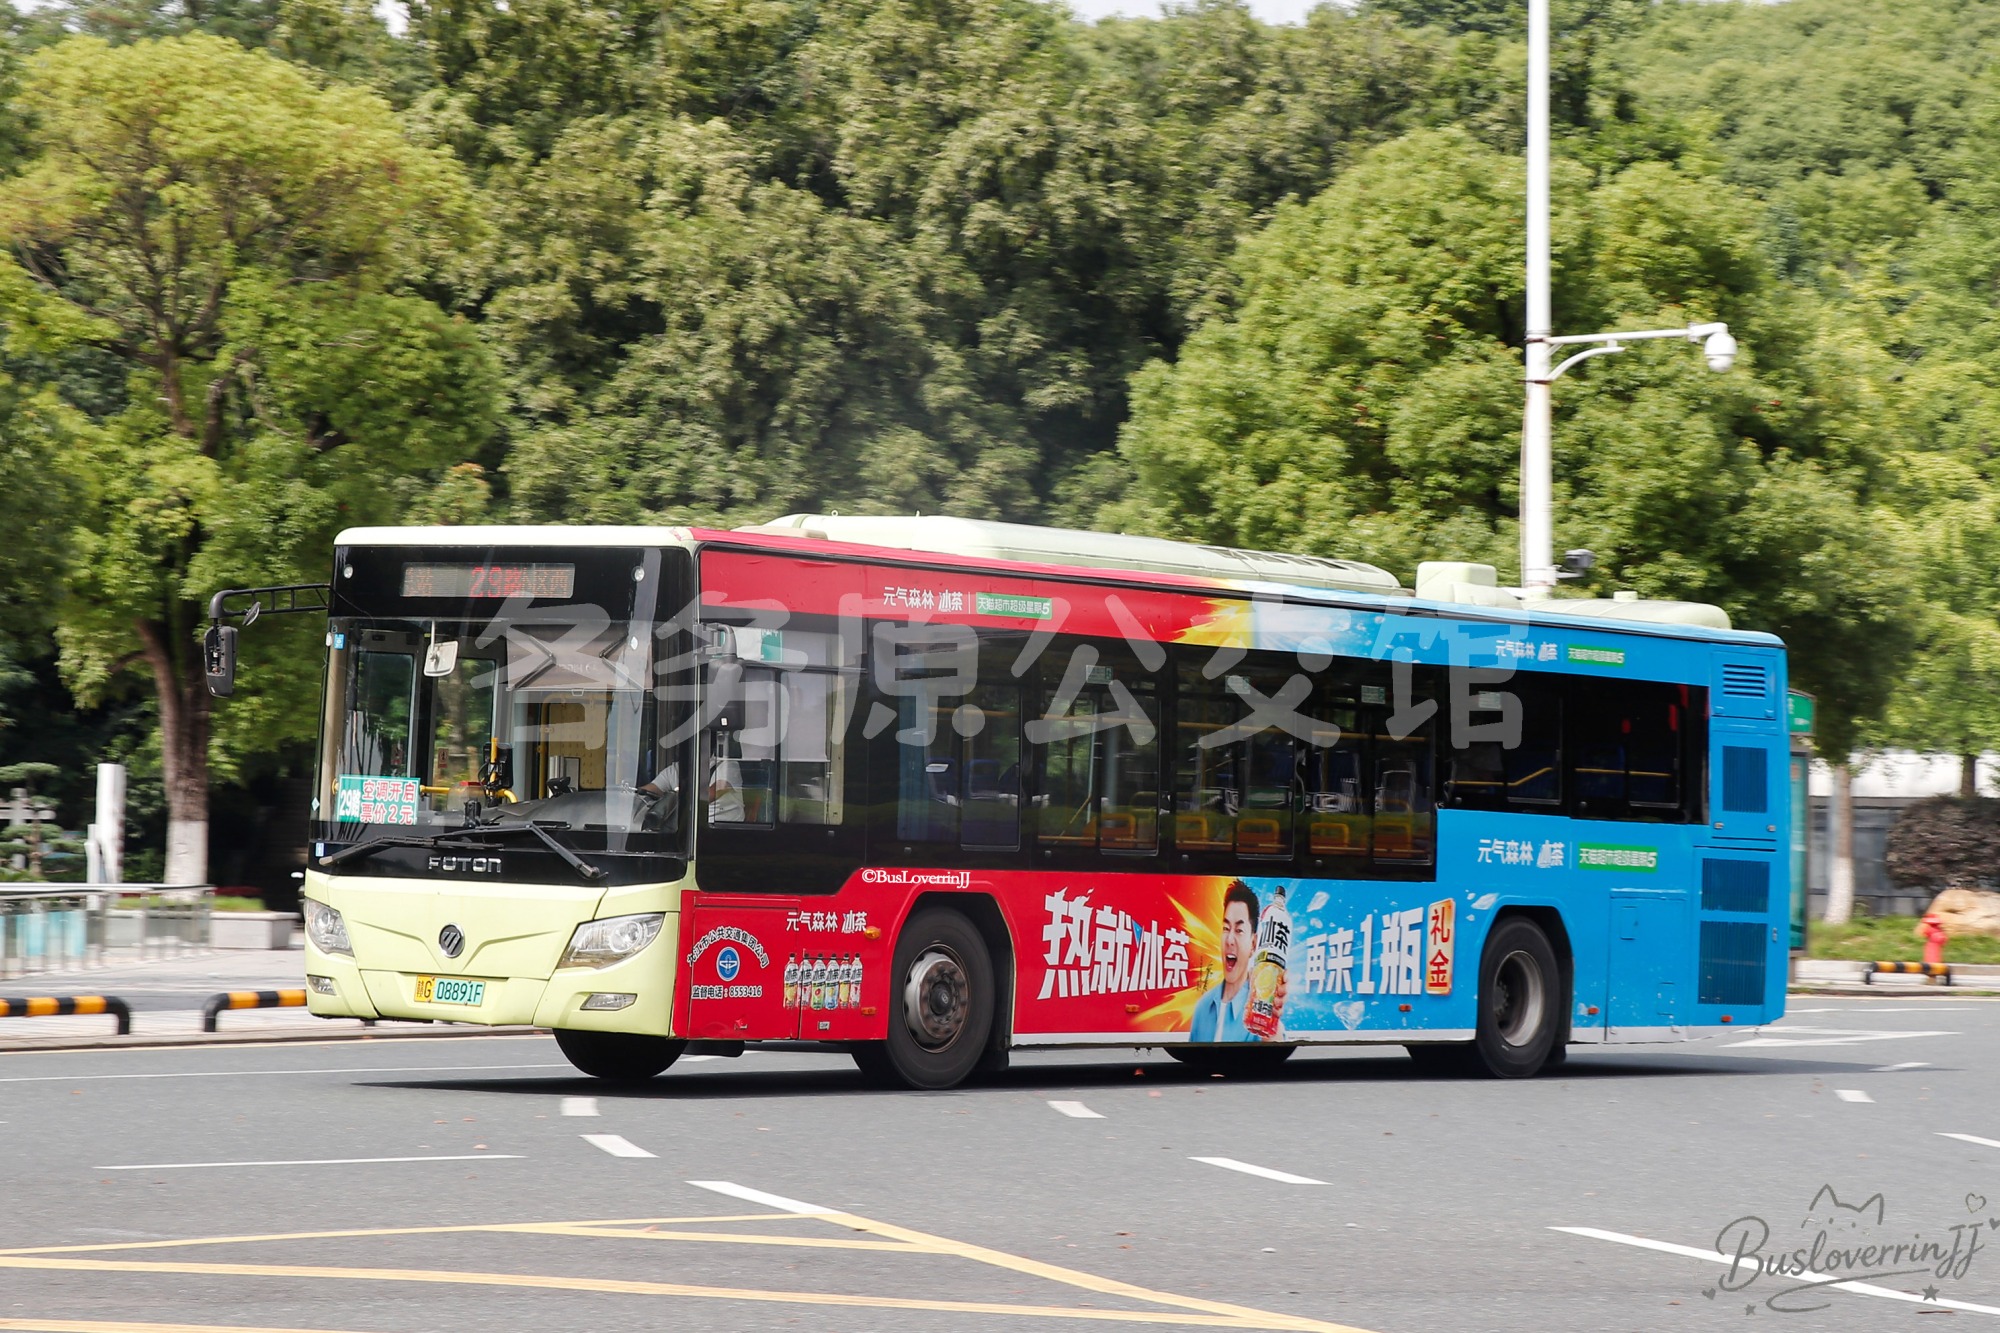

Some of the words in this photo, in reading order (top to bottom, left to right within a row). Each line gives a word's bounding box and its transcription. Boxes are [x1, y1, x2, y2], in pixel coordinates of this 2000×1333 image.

[884, 586, 935, 610] 元气森林
[938, 588, 963, 613] 冰茶
[361, 779, 417, 802] 空调开启
[360, 803, 414, 826] 票价2元
[428, 856, 502, 873] FOTON
[1477, 838, 1534, 866] 元气森林
[786, 910, 838, 933] 元气森林
[841, 909, 867, 934] 冰茶
[1258, 914, 1291, 955] 冰茶
[686, 926, 770, 969] 九江市公共交通集团公司
[1037, 887, 1190, 1000] 热就冰茶
[1305, 906, 1424, 995] 再来1瓶
[1428, 905, 1451, 988] 礼金
